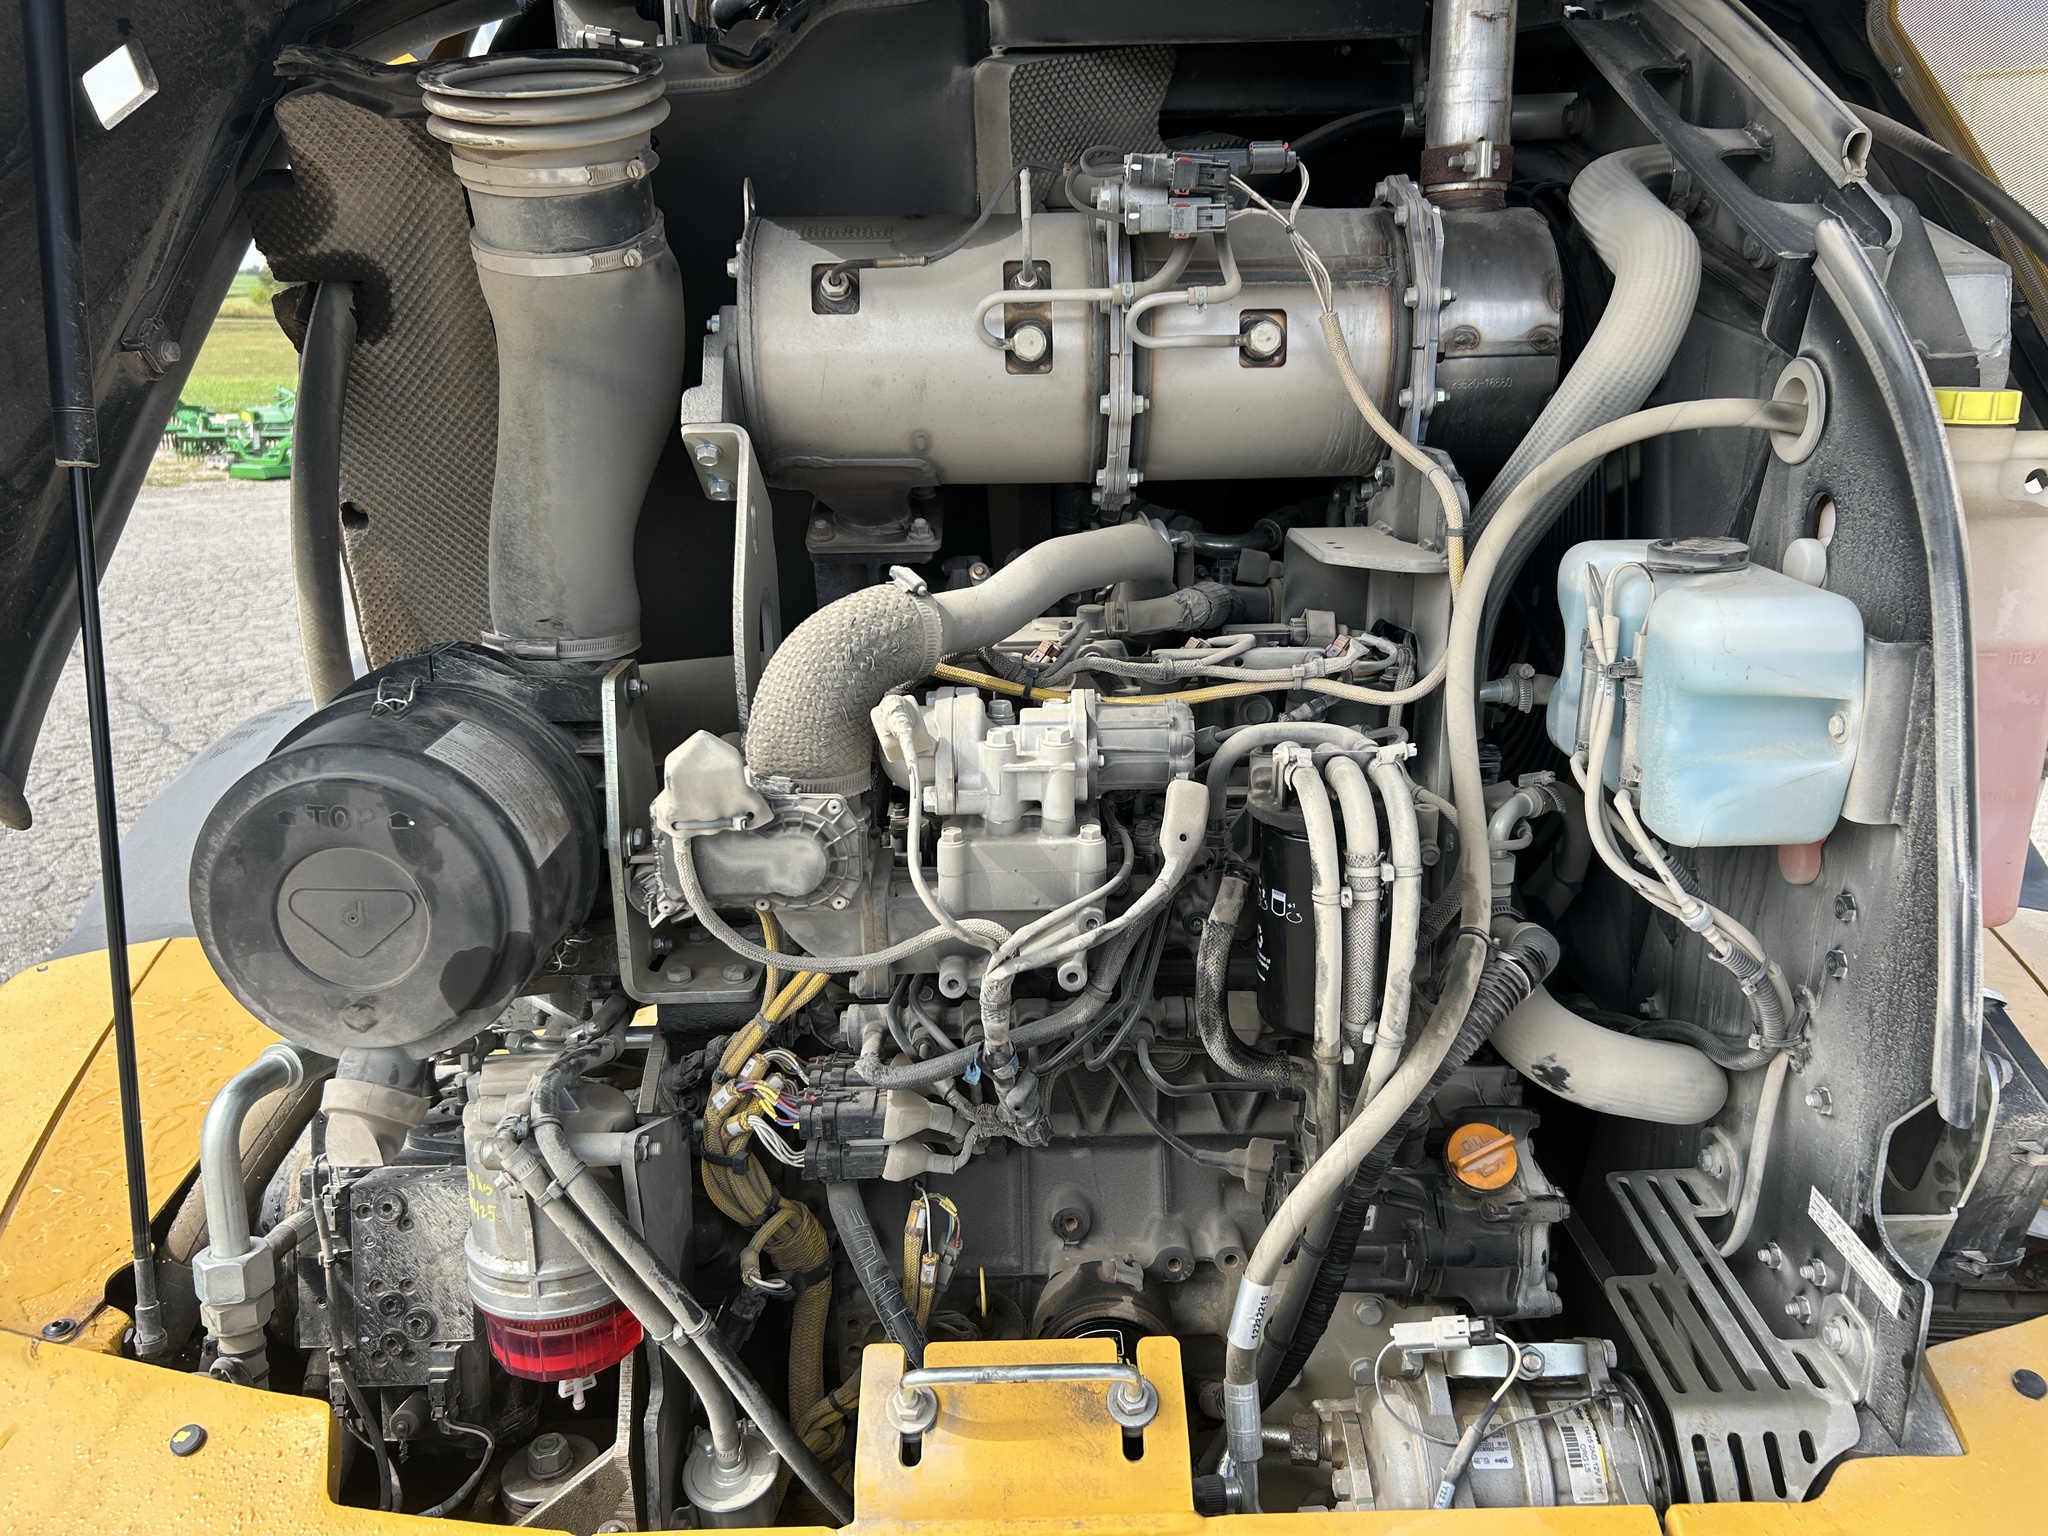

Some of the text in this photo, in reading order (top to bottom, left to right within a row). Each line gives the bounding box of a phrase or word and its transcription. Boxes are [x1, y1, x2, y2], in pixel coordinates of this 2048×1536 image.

[2008, 651, 2042, 665] max
[304, 804, 375, 832] TOP
[1461, 1136, 1490, 1152] OIL
[1251, 1295, 1269, 1340] 12222215
[1580, 1444, 1588, 1462] ORG
[1593, 1463, 1601, 1477] 12V
